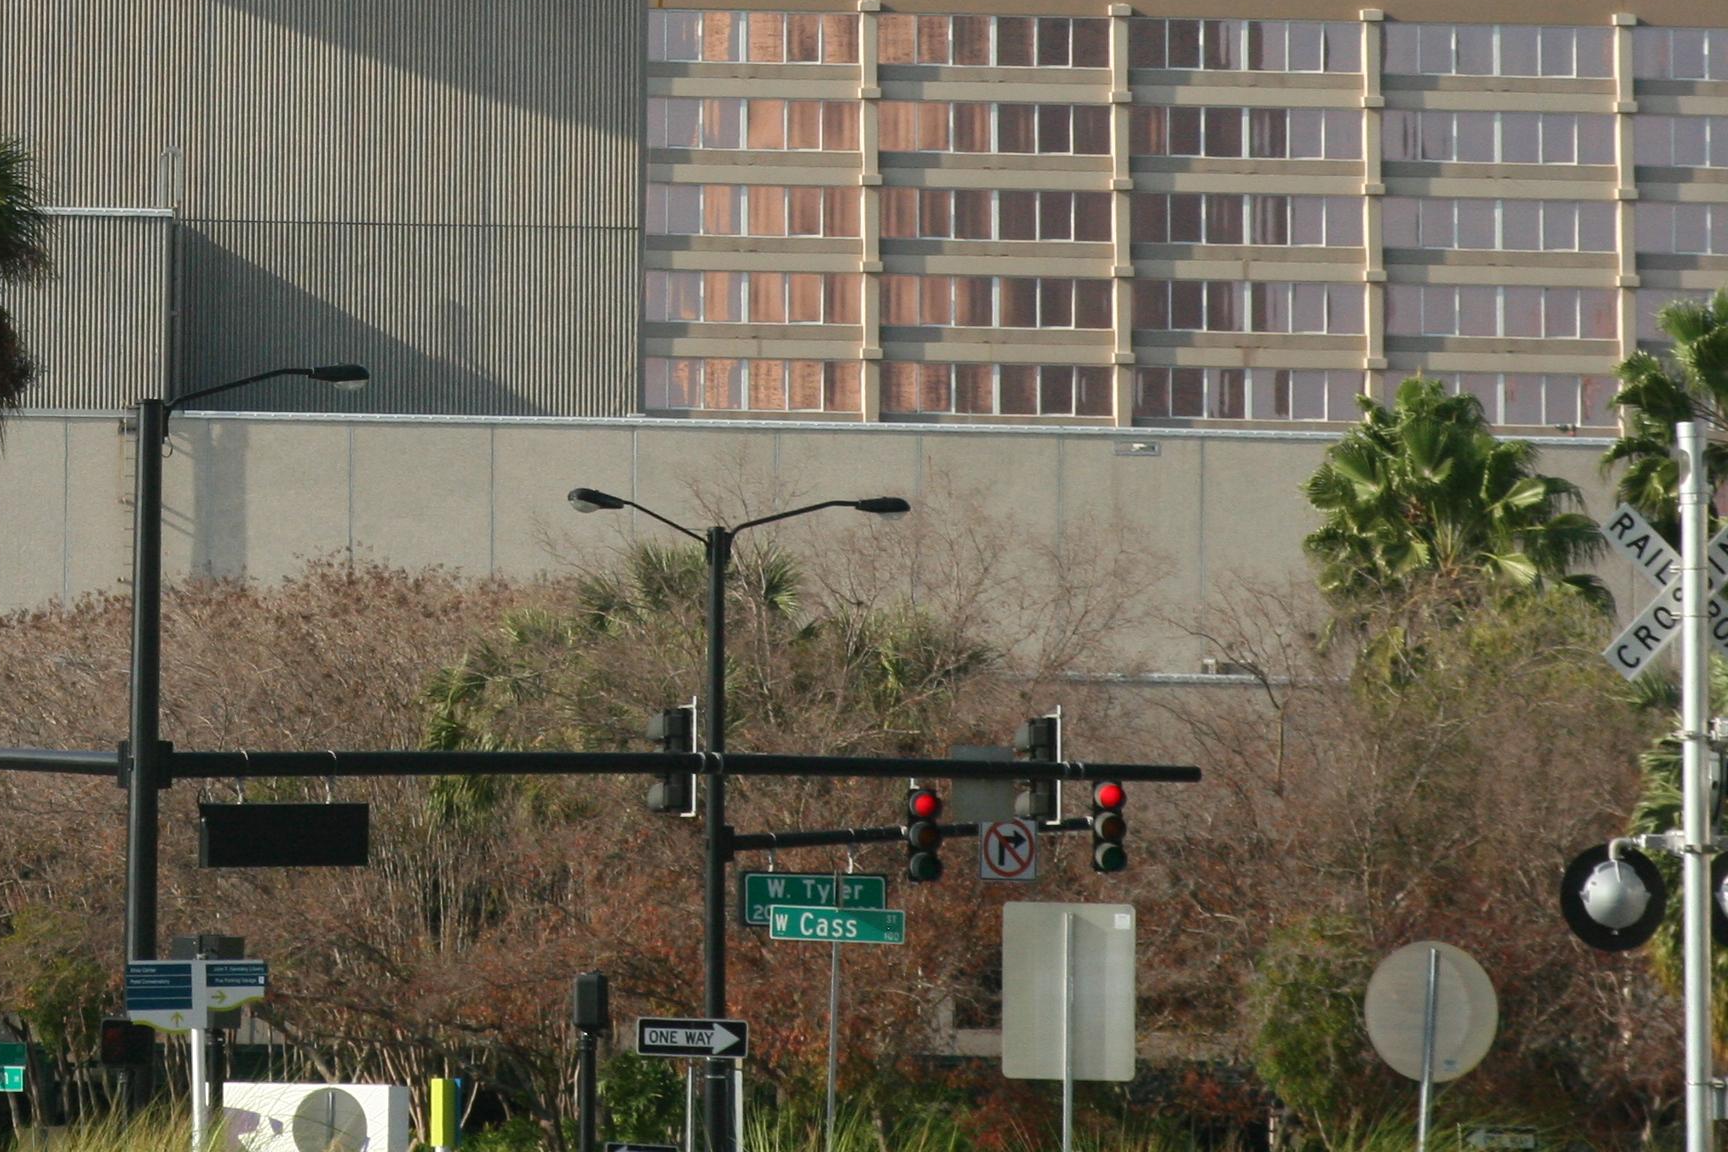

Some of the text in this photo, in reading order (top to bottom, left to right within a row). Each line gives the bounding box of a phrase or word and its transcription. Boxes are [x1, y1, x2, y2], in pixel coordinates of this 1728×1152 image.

[802, 879, 864, 904] Tyer
[775, 913, 789, 932] W
[799, 911, 858, 939] Cass
[648, 1029, 714, 1046] ONE WAY
